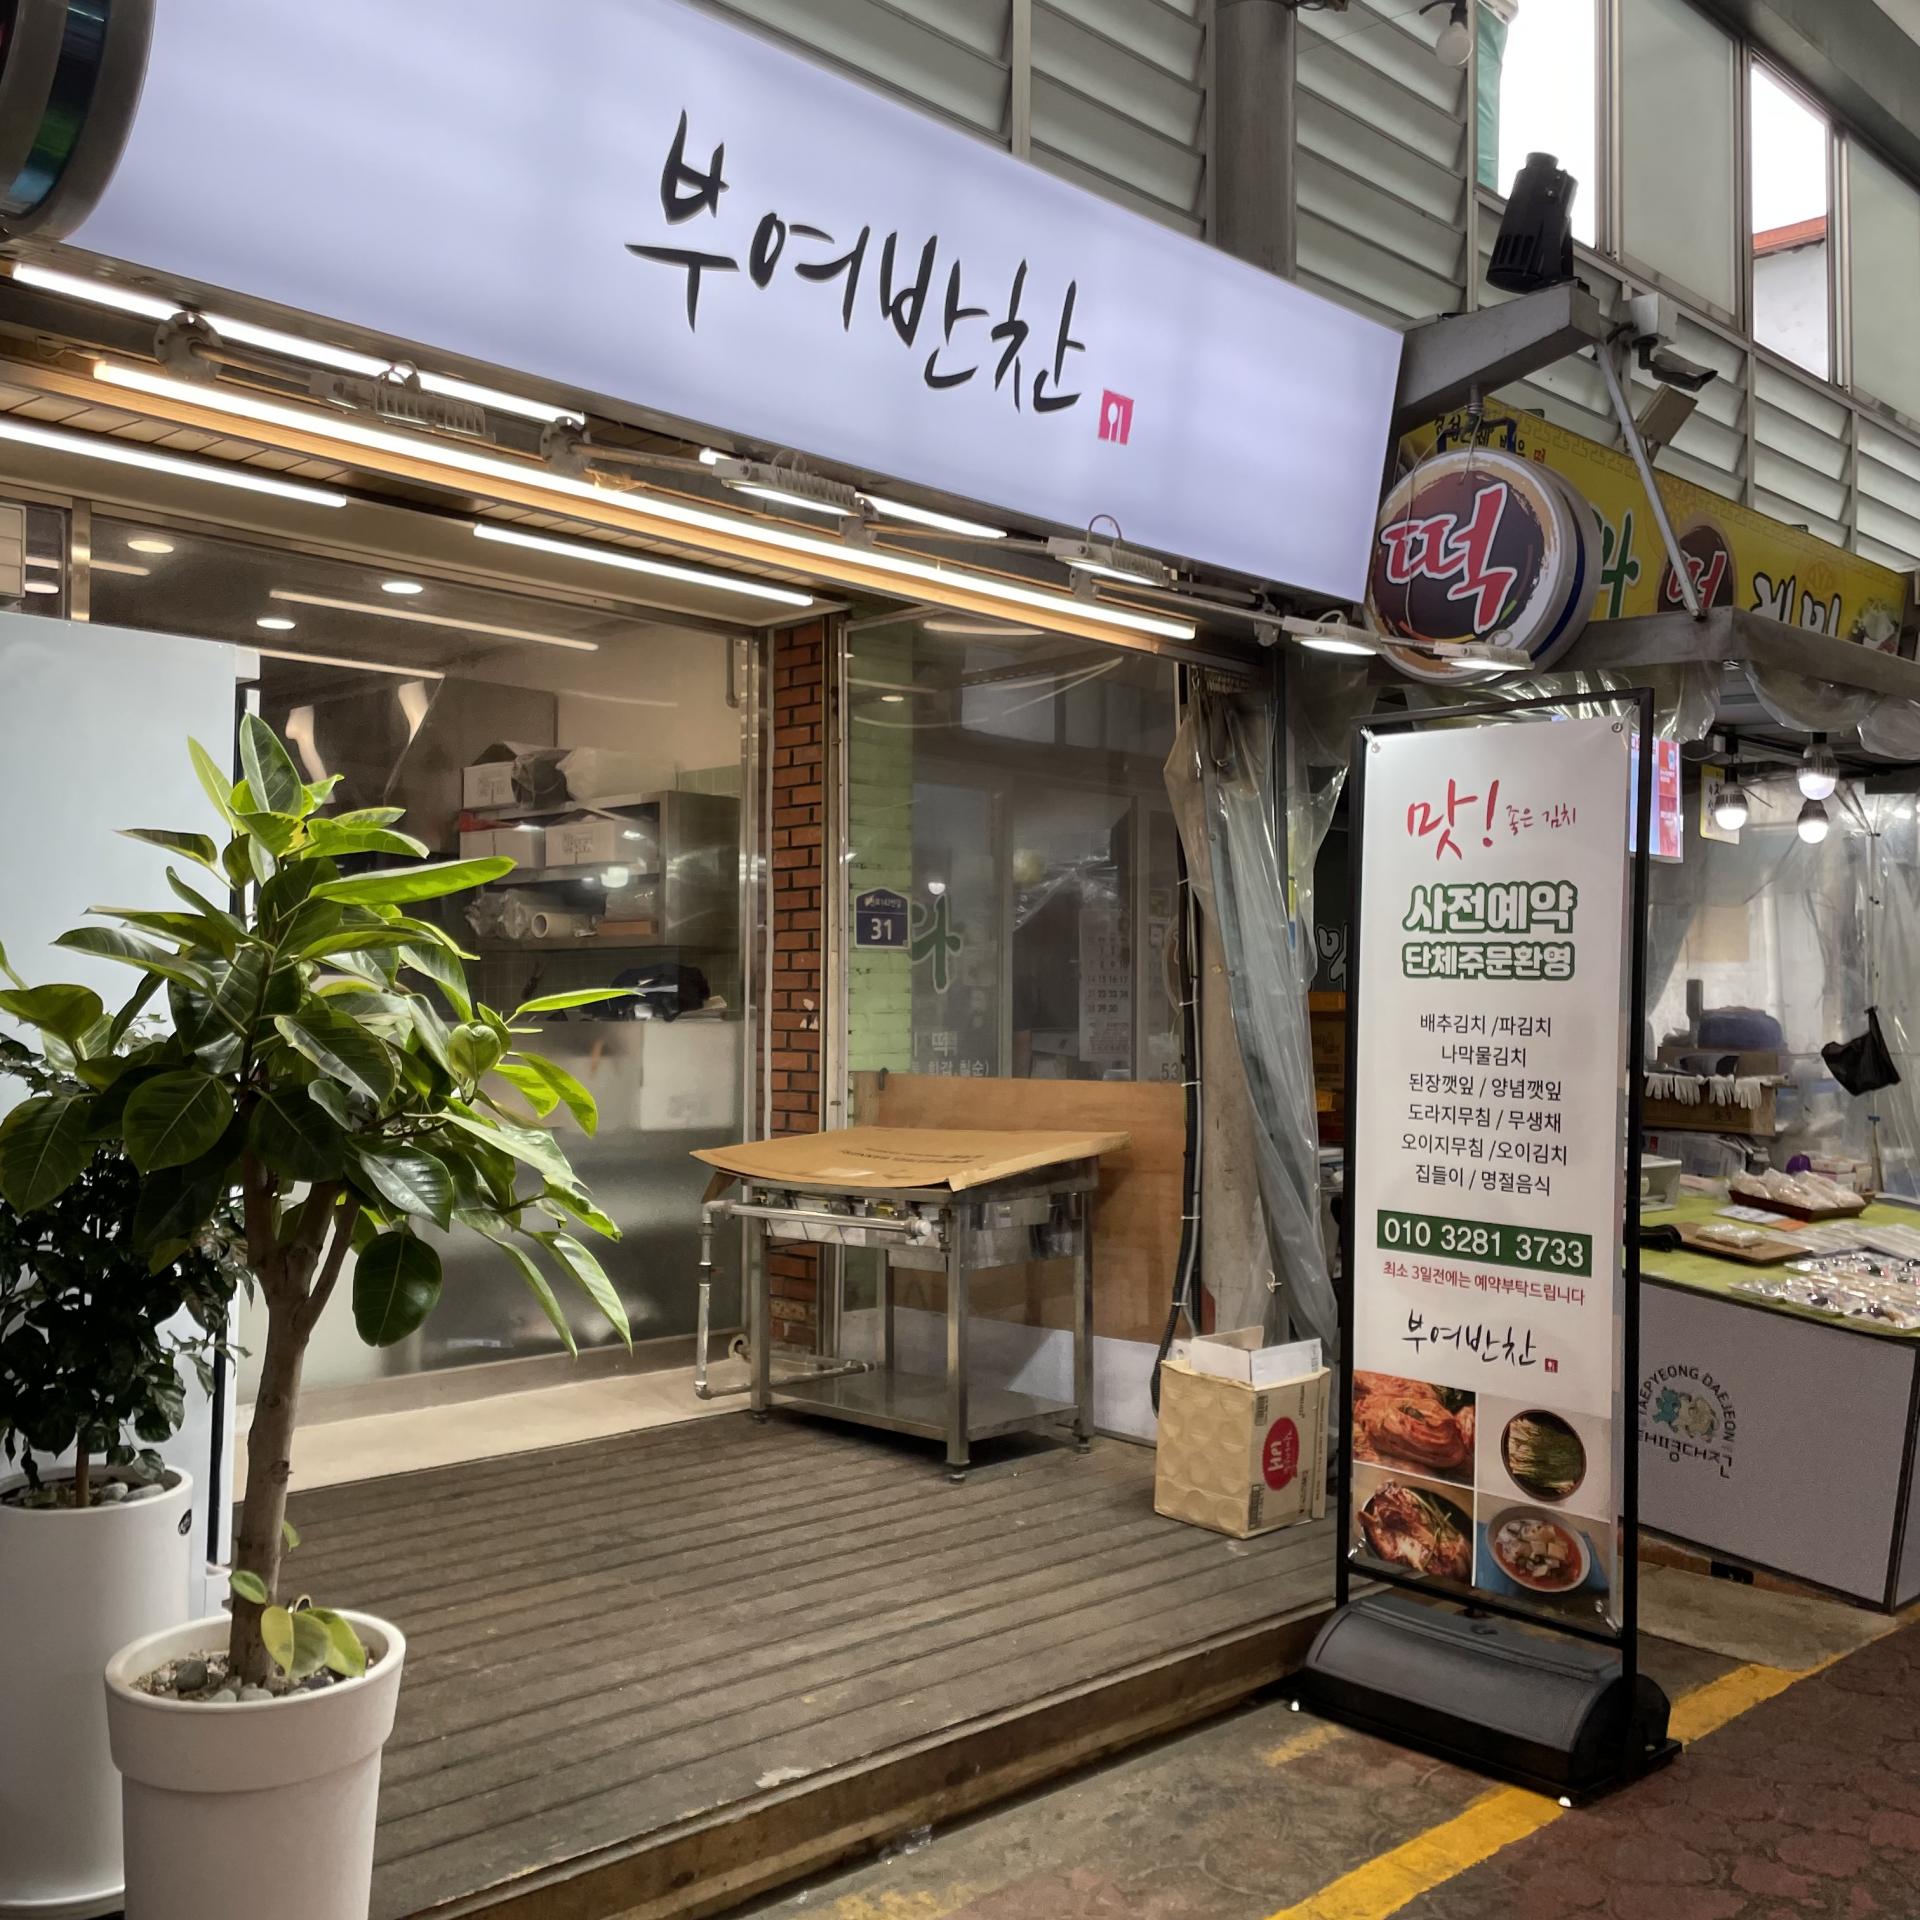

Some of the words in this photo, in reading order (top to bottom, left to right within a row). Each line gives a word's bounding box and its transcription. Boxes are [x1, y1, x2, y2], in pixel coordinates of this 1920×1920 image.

[624, 109, 1086, 414] 부여반찬
[1379, 481, 1518, 635] 떡
[1407, 778, 1499, 861] 맛!
[1506, 804, 1533, 836] 좋은
[1542, 802, 1576, 830] 김치
[1402, 880, 1578, 934] 사전예약
[870, 918, 892, 940] 31
[1402, 941, 1576, 981] 단체주문환영
[1420, 1013, 1486, 1035] 배추김치
[1441, 1045, 1527, 1068] 나막물김치
[1409, 1073, 1474, 1096] 된장깻잎
[1491, 1078, 1562, 1101] 양념깻잎
[1408, 1103, 1491, 1128] 도라지무침
[1508, 1110, 1562, 1133] 무생채
[1401, 1133, 1483, 1158] 오이지무침
[1415, 1164, 1464, 1187] 집들이
[1481, 1171, 1550, 1196] 명절음식
[1384, 1218, 1431, 1247] 010
[1440, 1224, 1501, 1257] 3281
[1515, 1233, 1584, 1268] 3733
[1383, 1261, 1409, 1278] 최소
[1412, 1265, 1471, 1289] 3일전에는
[1474, 1274, 1585, 1306] 예약부탁드립니다
[1402, 1308, 1537, 1366] 부여반찬
